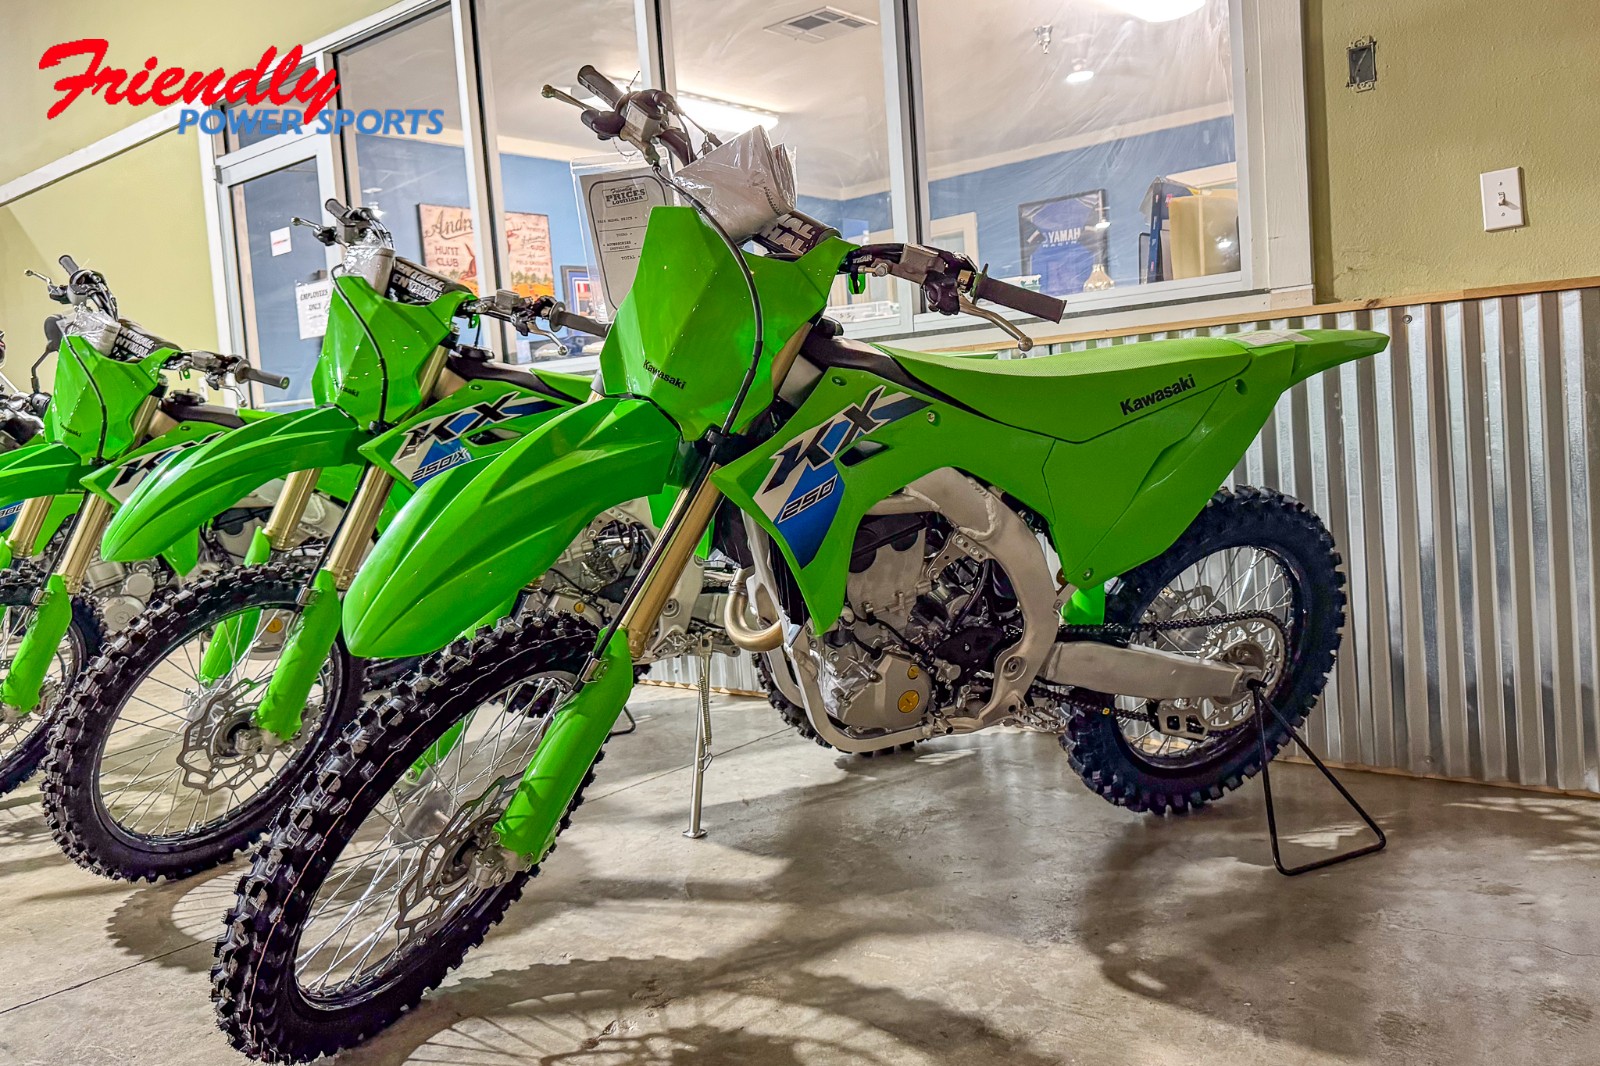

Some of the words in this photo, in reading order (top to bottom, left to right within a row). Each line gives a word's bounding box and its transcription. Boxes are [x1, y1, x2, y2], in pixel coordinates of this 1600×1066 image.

[605, 188, 646, 202] PRICES
[612, 195, 644, 205] LOUISIANA
[1048, 227, 1081, 244] YAMAH
[434, 246, 459, 256] HUNT
[435, 257, 459, 267] CLUB
[642, 359, 688, 390] Kawasaki
[1120, 373, 1196, 416] Kawasaki
[397, 391, 520, 460] KX
[762, 385, 891, 496] KX
[778, 475, 838, 524] 250
